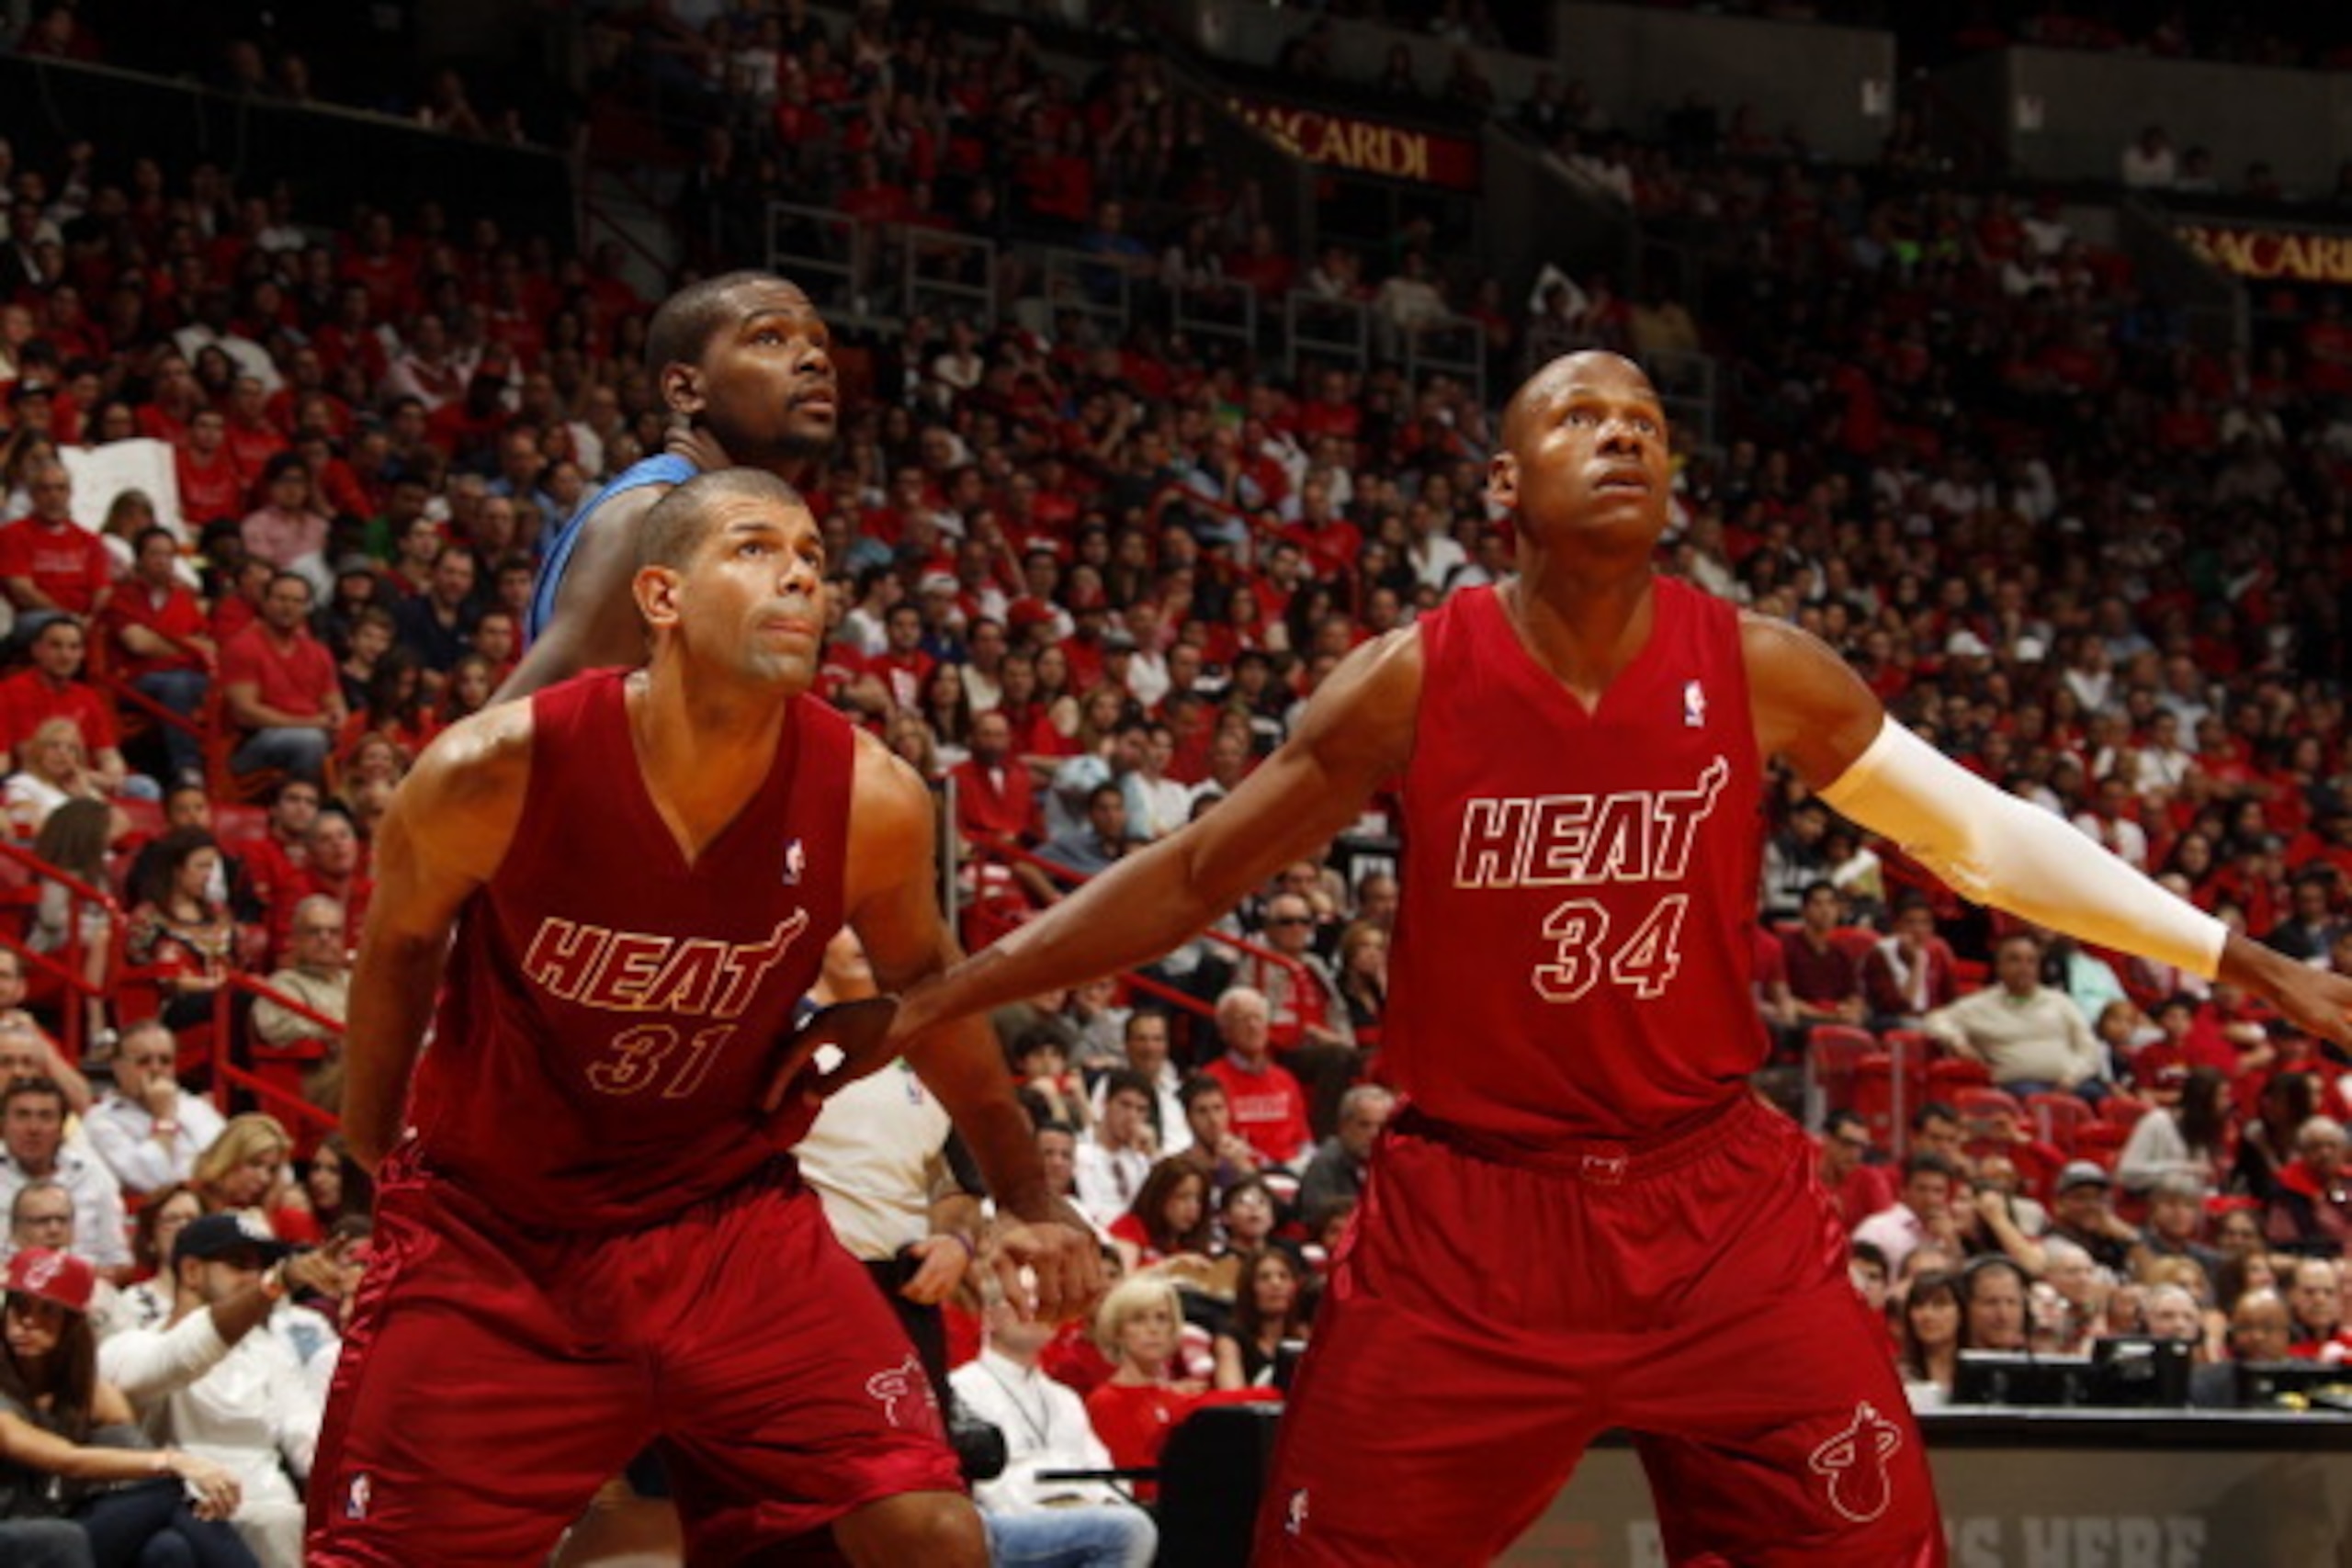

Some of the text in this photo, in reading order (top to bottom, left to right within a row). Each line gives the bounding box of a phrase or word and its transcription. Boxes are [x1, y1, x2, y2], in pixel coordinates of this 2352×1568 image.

[1453, 753, 1729, 889] HEAT
[521, 907, 809, 1018] HEAT
[1531, 893, 1689, 1004] 34
[585, 1023, 739, 1099] 31
